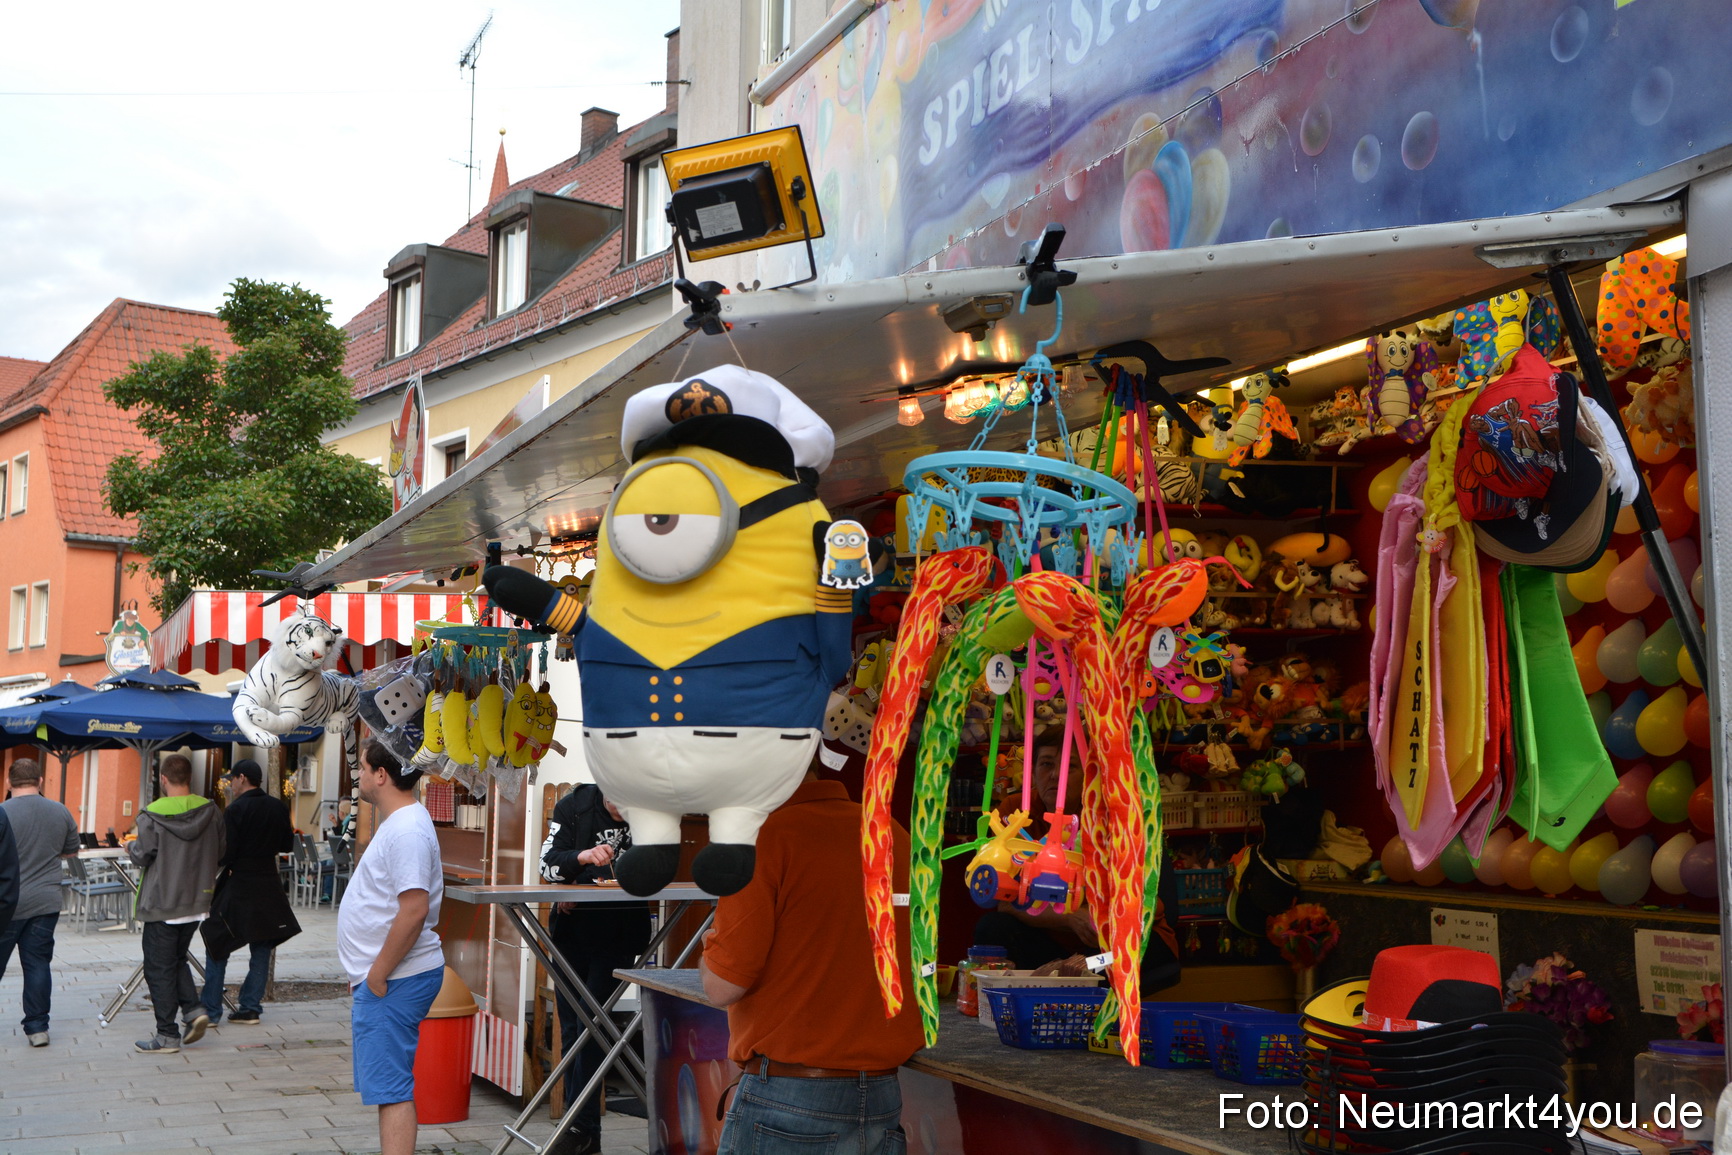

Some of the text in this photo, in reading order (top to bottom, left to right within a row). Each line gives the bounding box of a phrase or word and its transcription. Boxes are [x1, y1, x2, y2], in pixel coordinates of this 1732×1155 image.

[918, 23, 1041, 166] SPIEL
[995, 661, 1007, 679] R
[1408, 640, 1423, 789] SCHATZ
